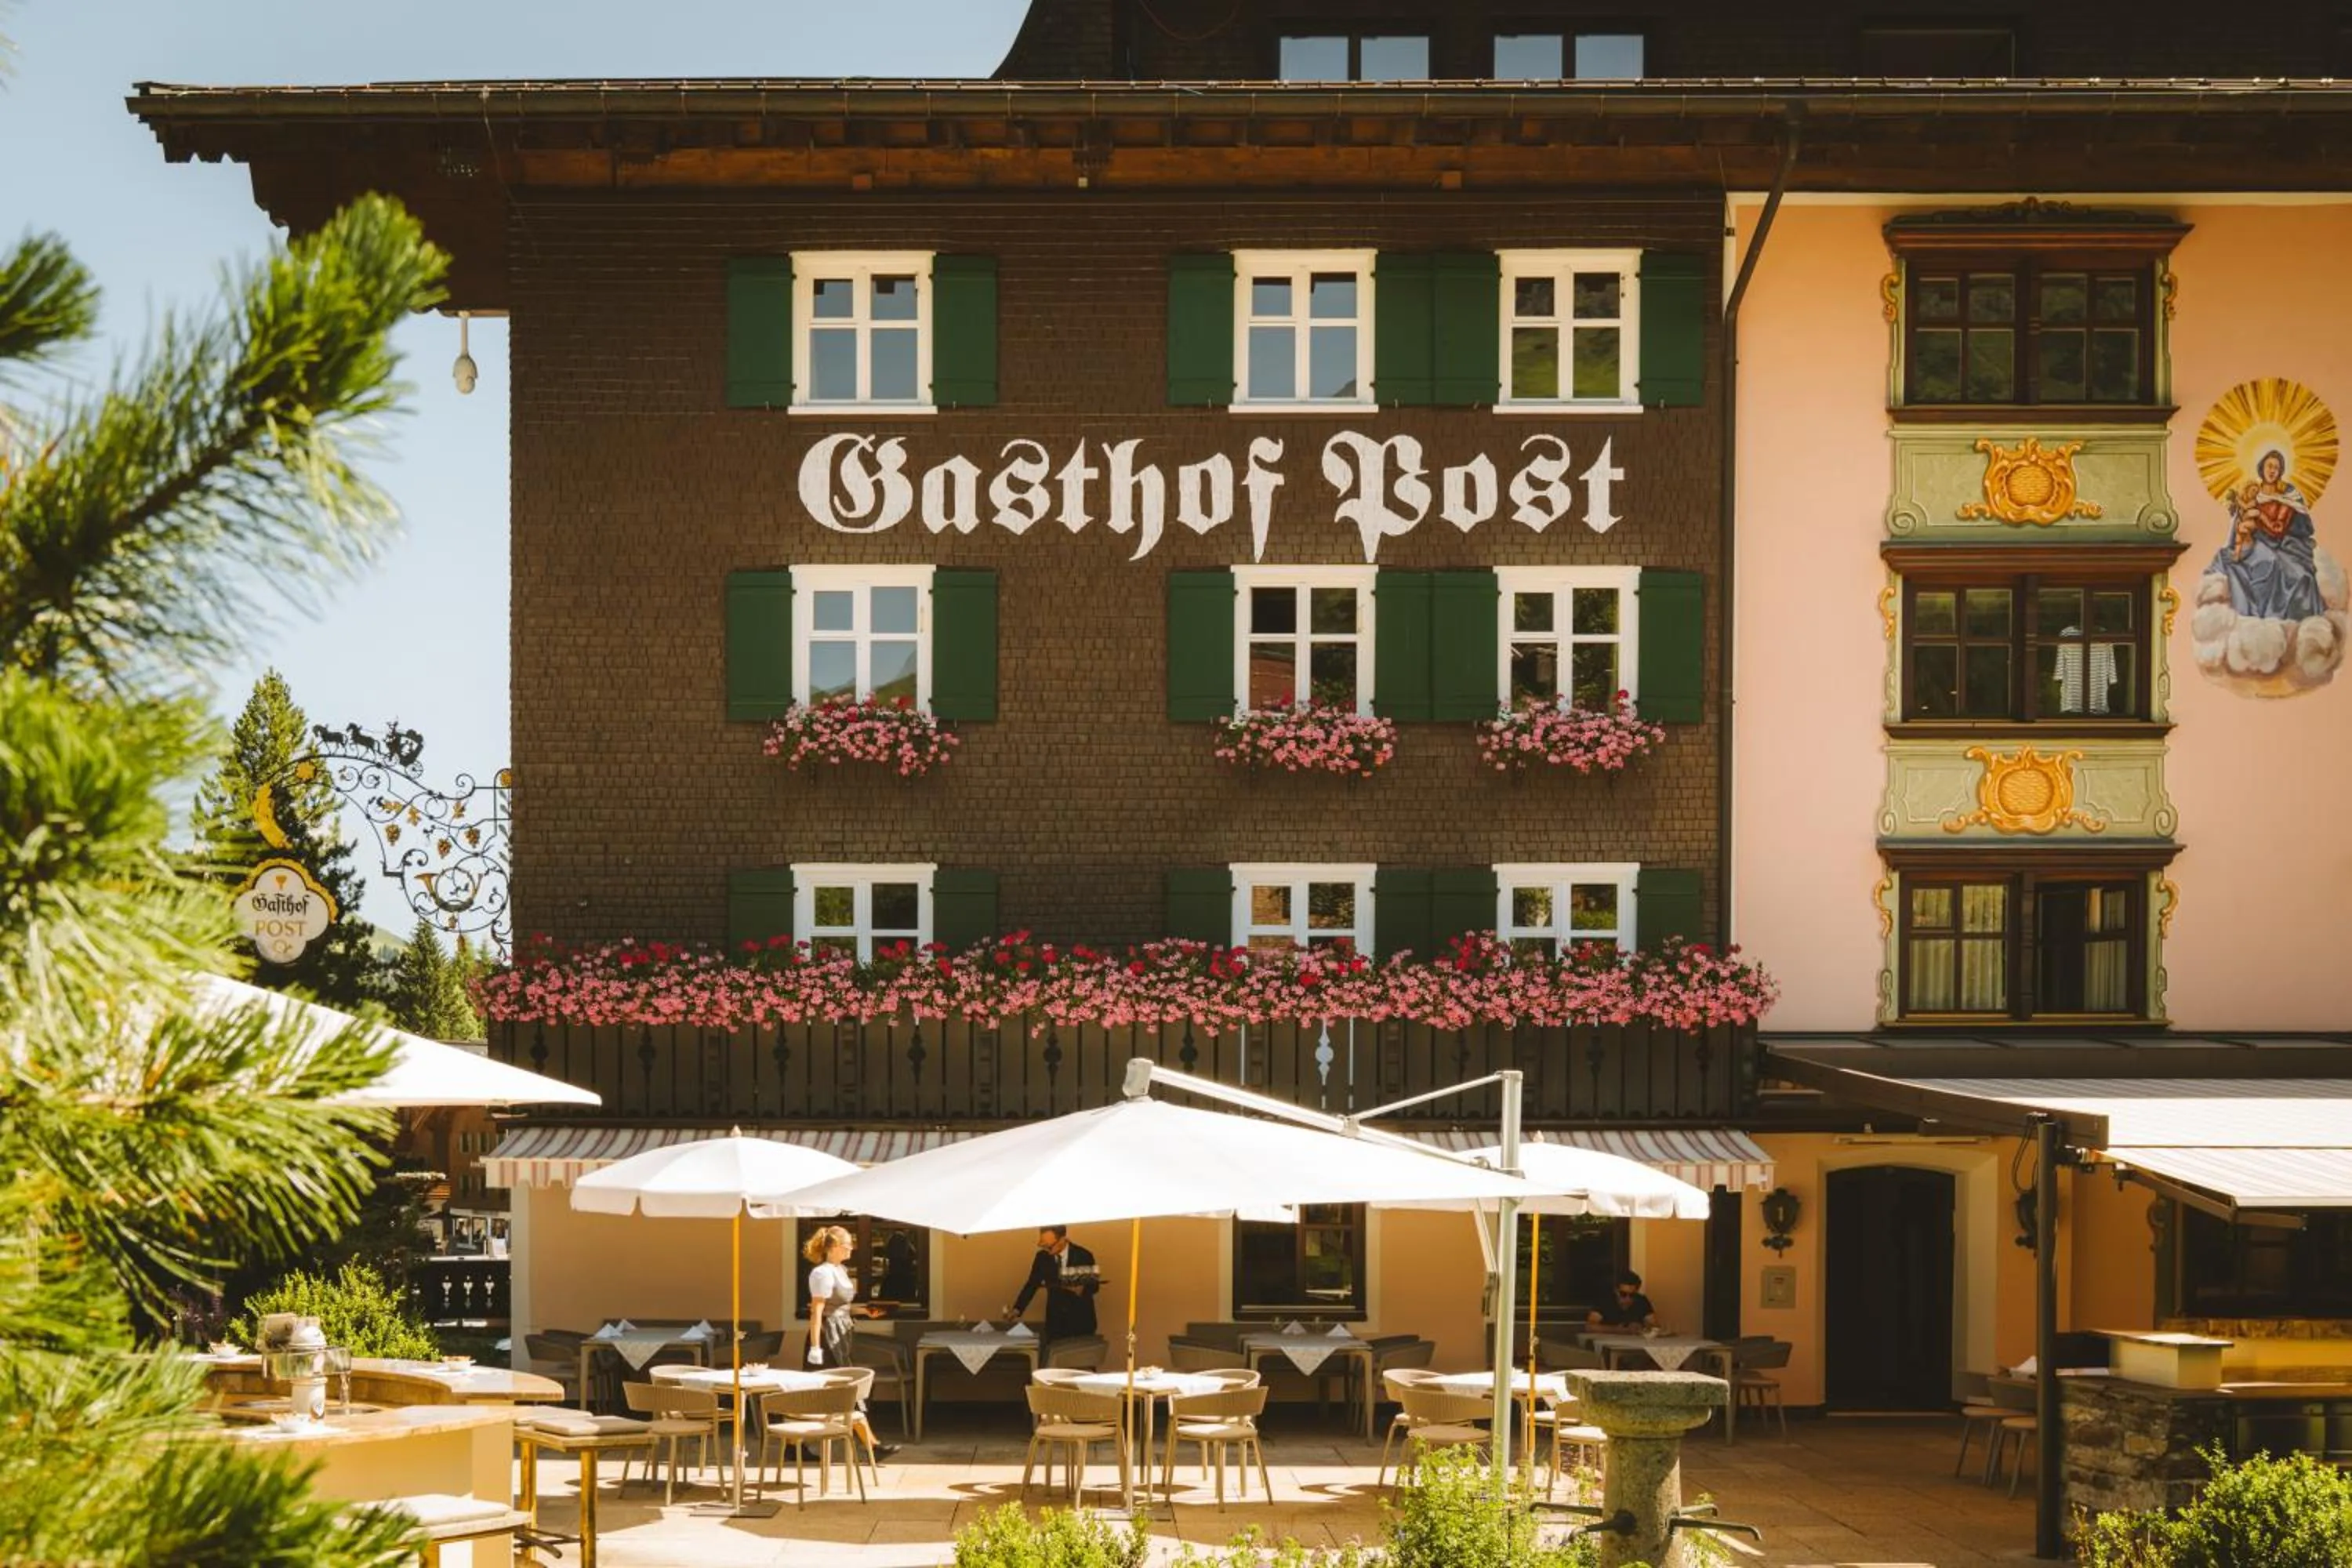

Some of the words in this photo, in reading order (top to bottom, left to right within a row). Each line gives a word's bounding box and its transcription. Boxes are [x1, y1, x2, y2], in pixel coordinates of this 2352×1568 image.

[798, 434, 1284, 563] Gasthof
[1322, 430, 1624, 563] Post
[255, 919, 307, 937] POST
